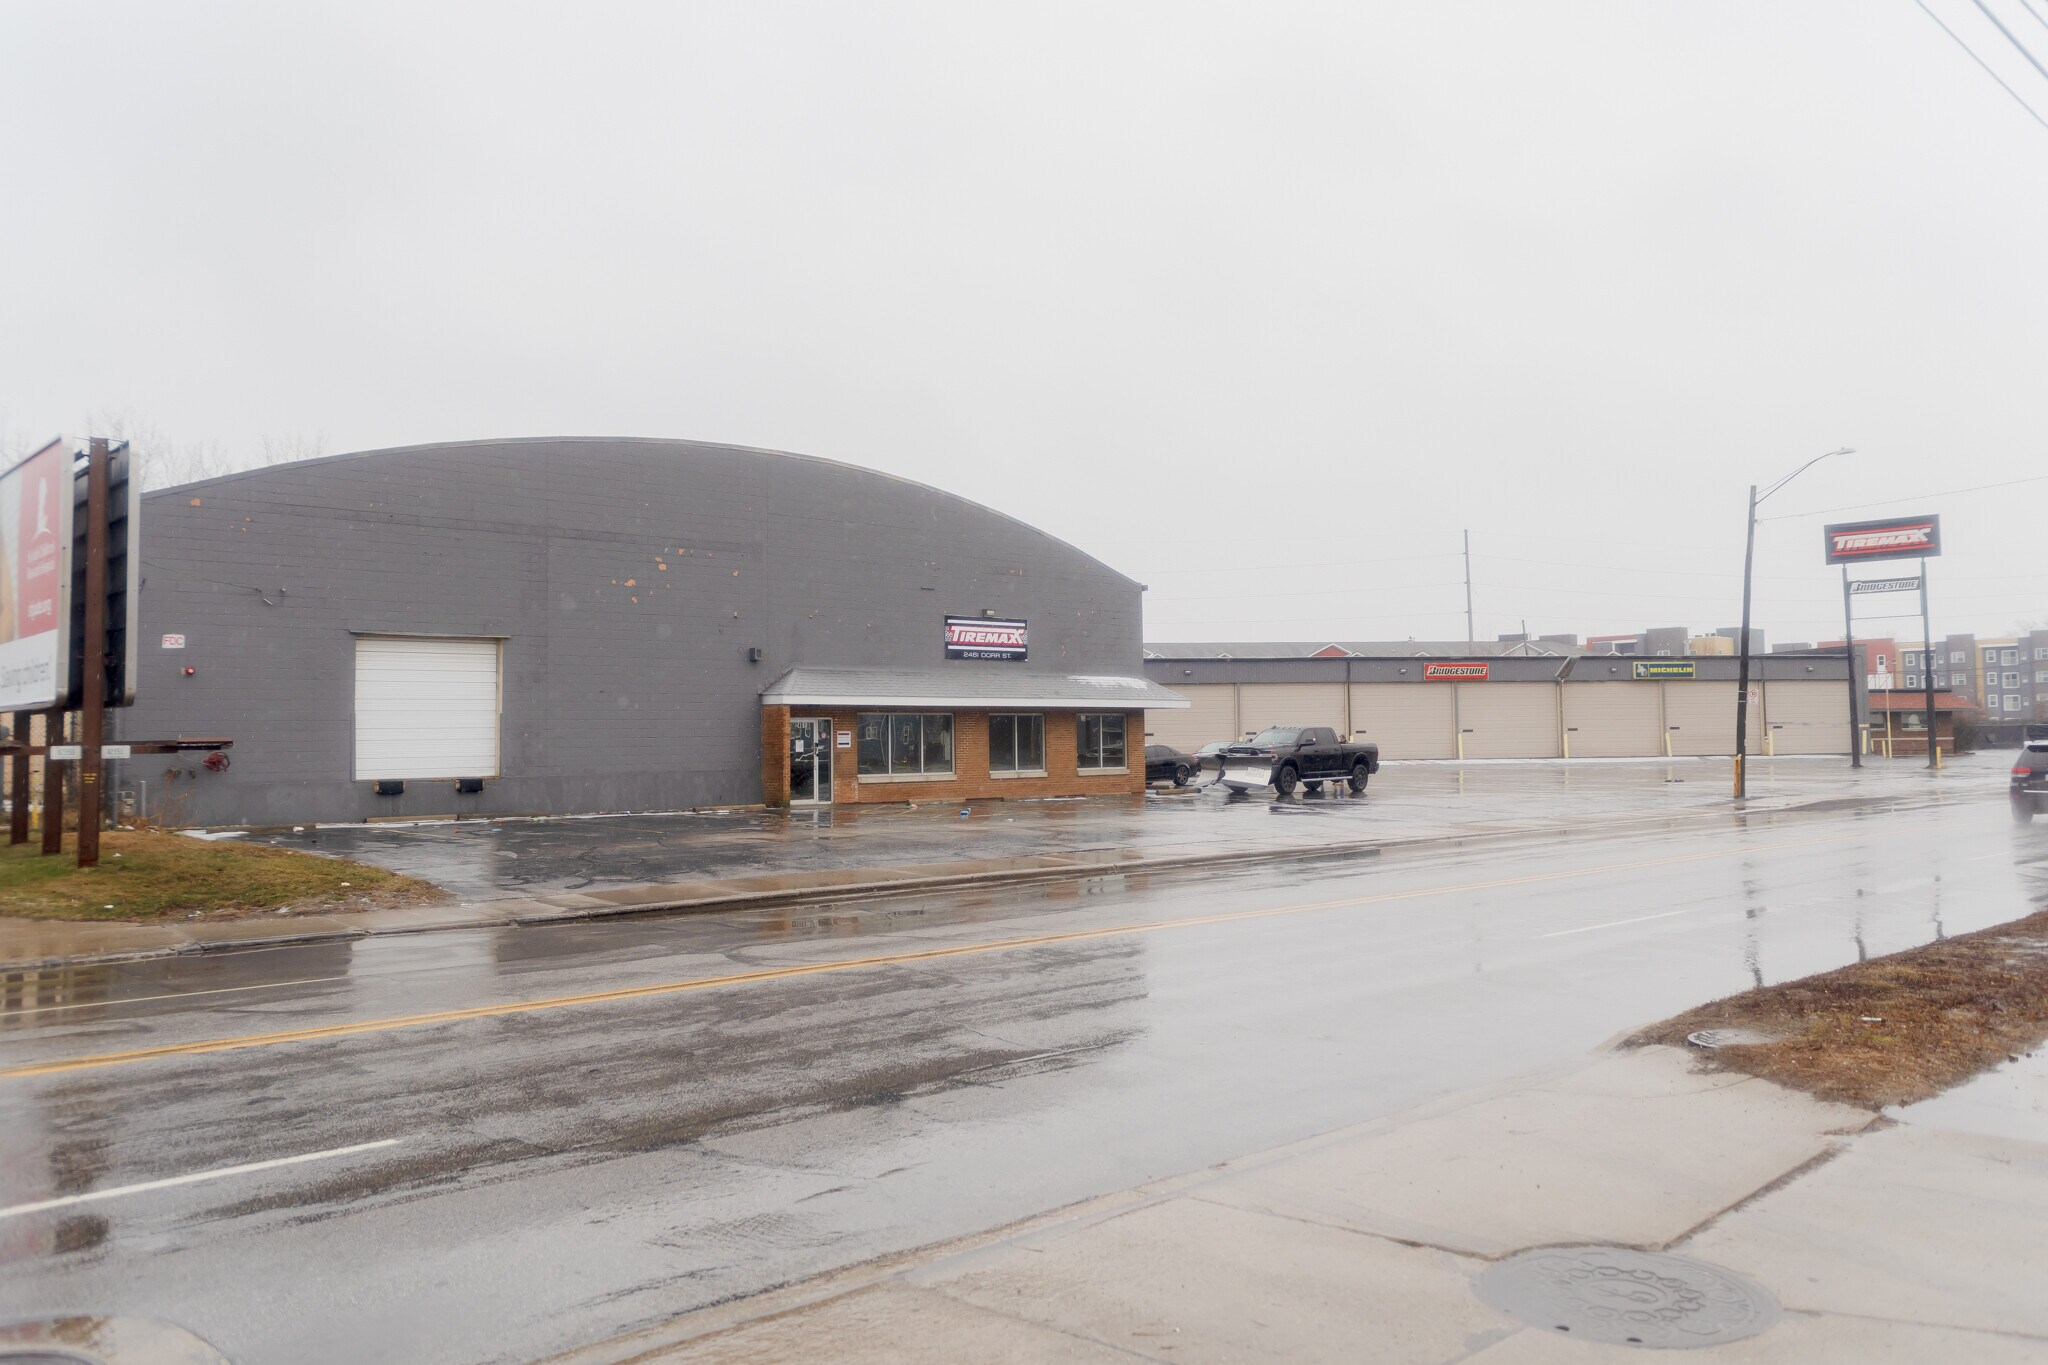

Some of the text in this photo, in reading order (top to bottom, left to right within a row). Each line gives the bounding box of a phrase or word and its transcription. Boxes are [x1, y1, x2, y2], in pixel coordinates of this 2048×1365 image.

[1832, 527, 1932, 550] TIREMAX
[1851, 580, 1918, 592] BRIDGESTONE
[164, 636, 184, 646] FDC
[950, 625, 1025, 645] TIREMAX
[1428, 666, 1486, 675] BRIDGESTONE
